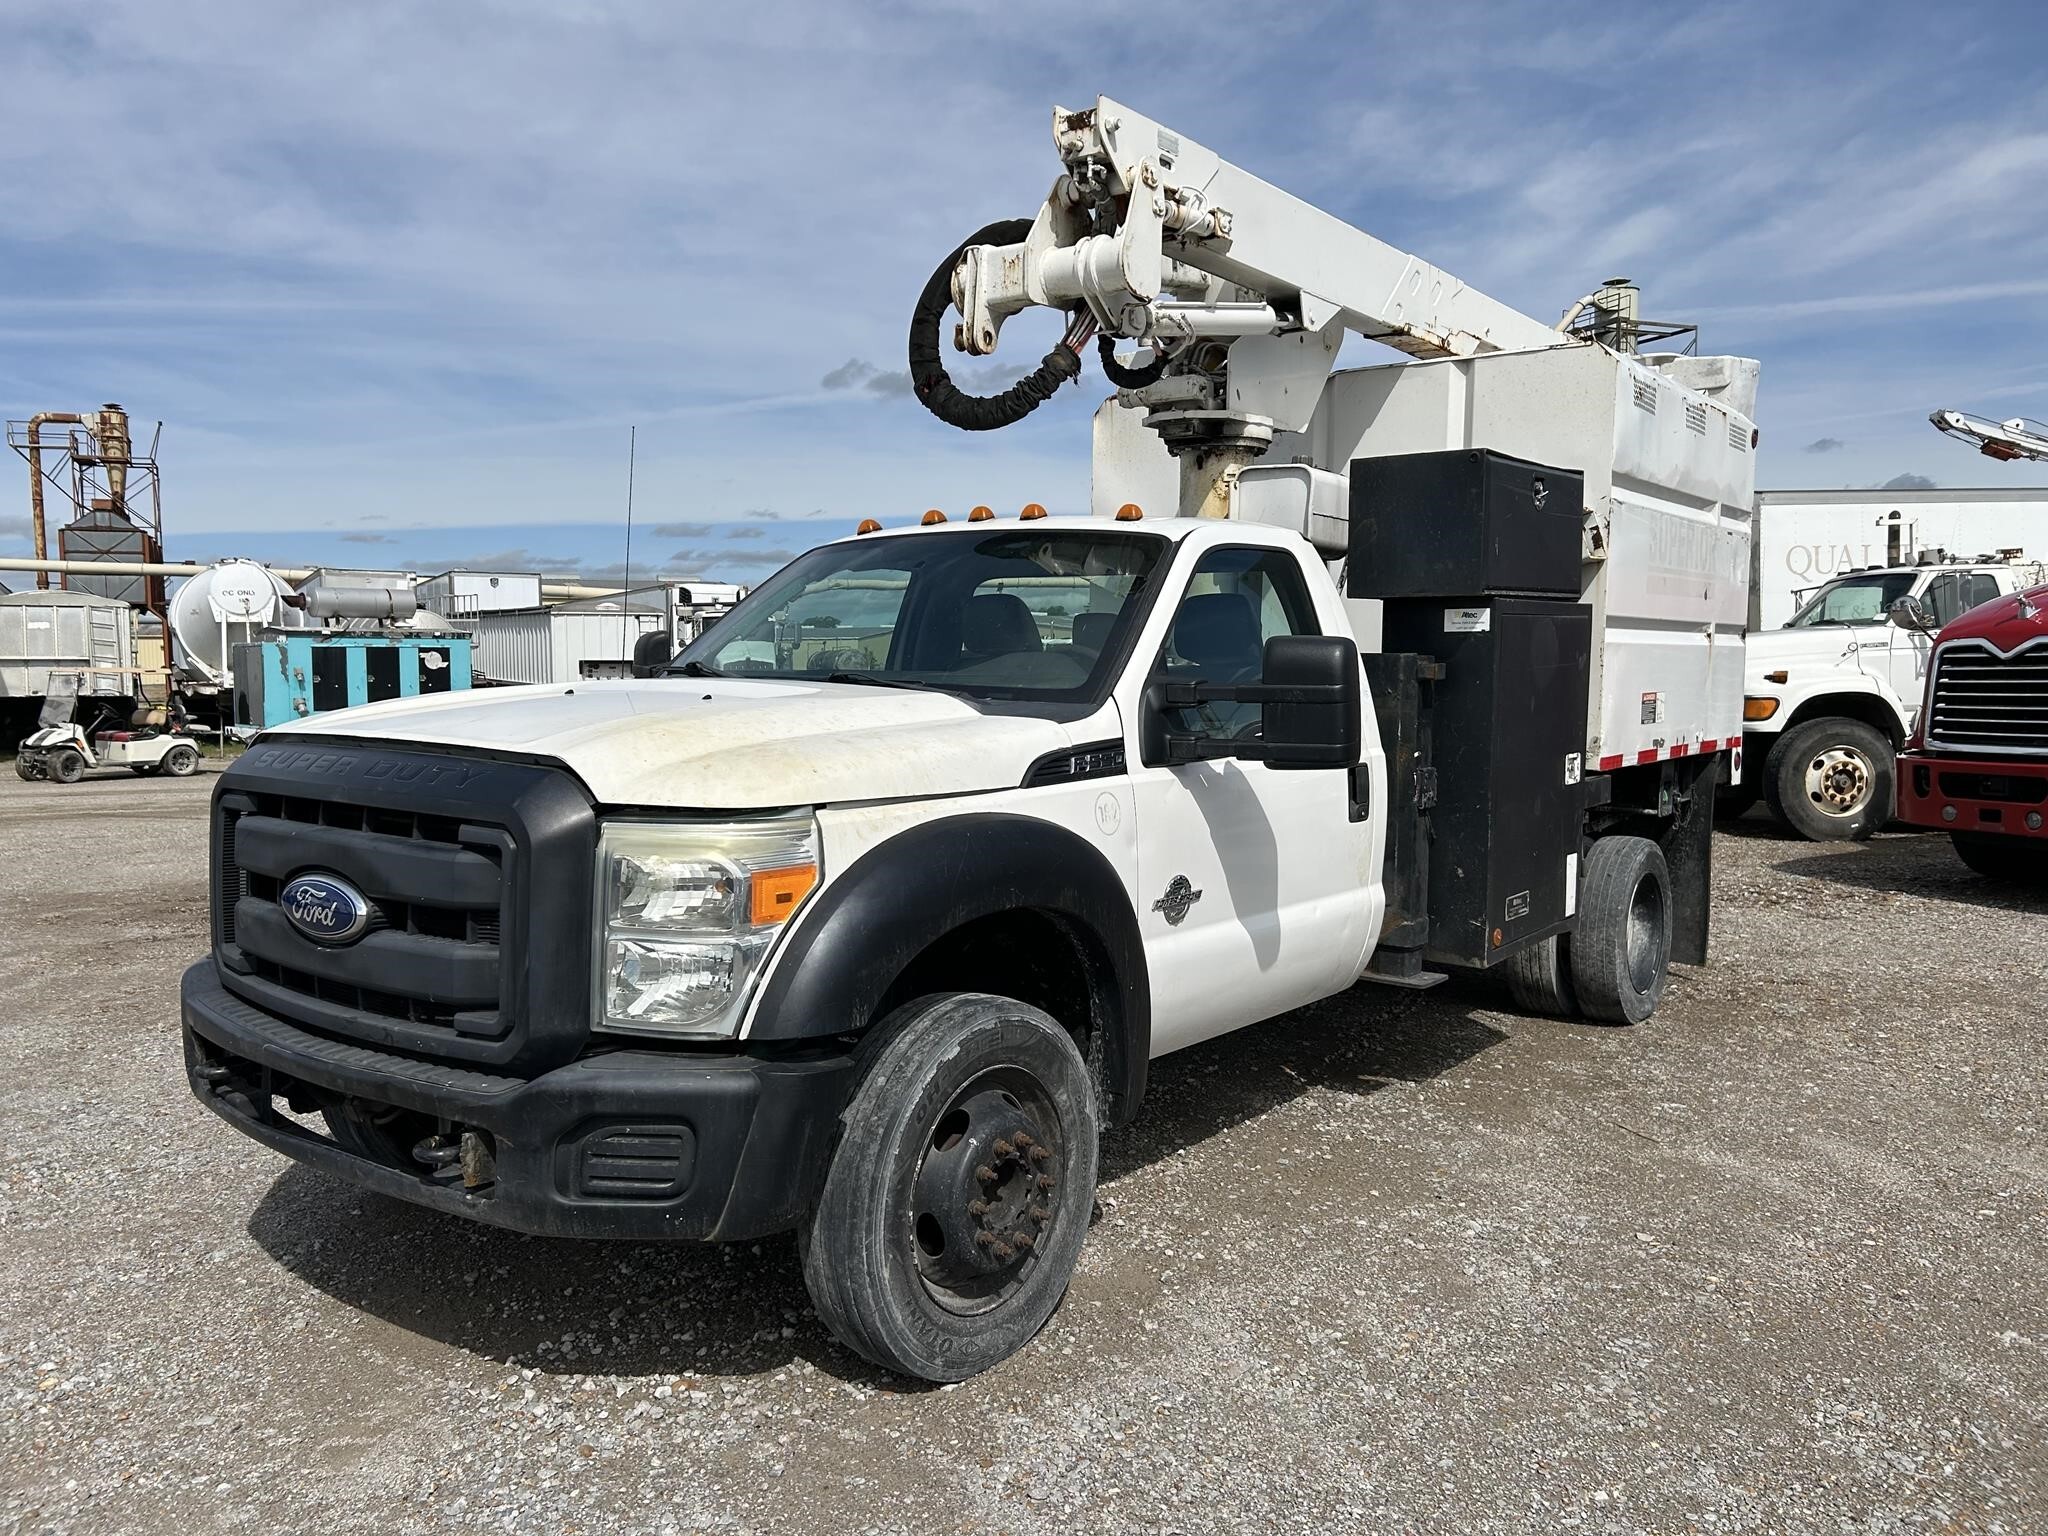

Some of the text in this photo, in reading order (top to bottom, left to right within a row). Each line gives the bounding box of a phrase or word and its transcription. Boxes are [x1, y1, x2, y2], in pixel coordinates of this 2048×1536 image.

[254, 750, 490, 789] SUPER DUTY
[292, 886, 338, 926] Ford
